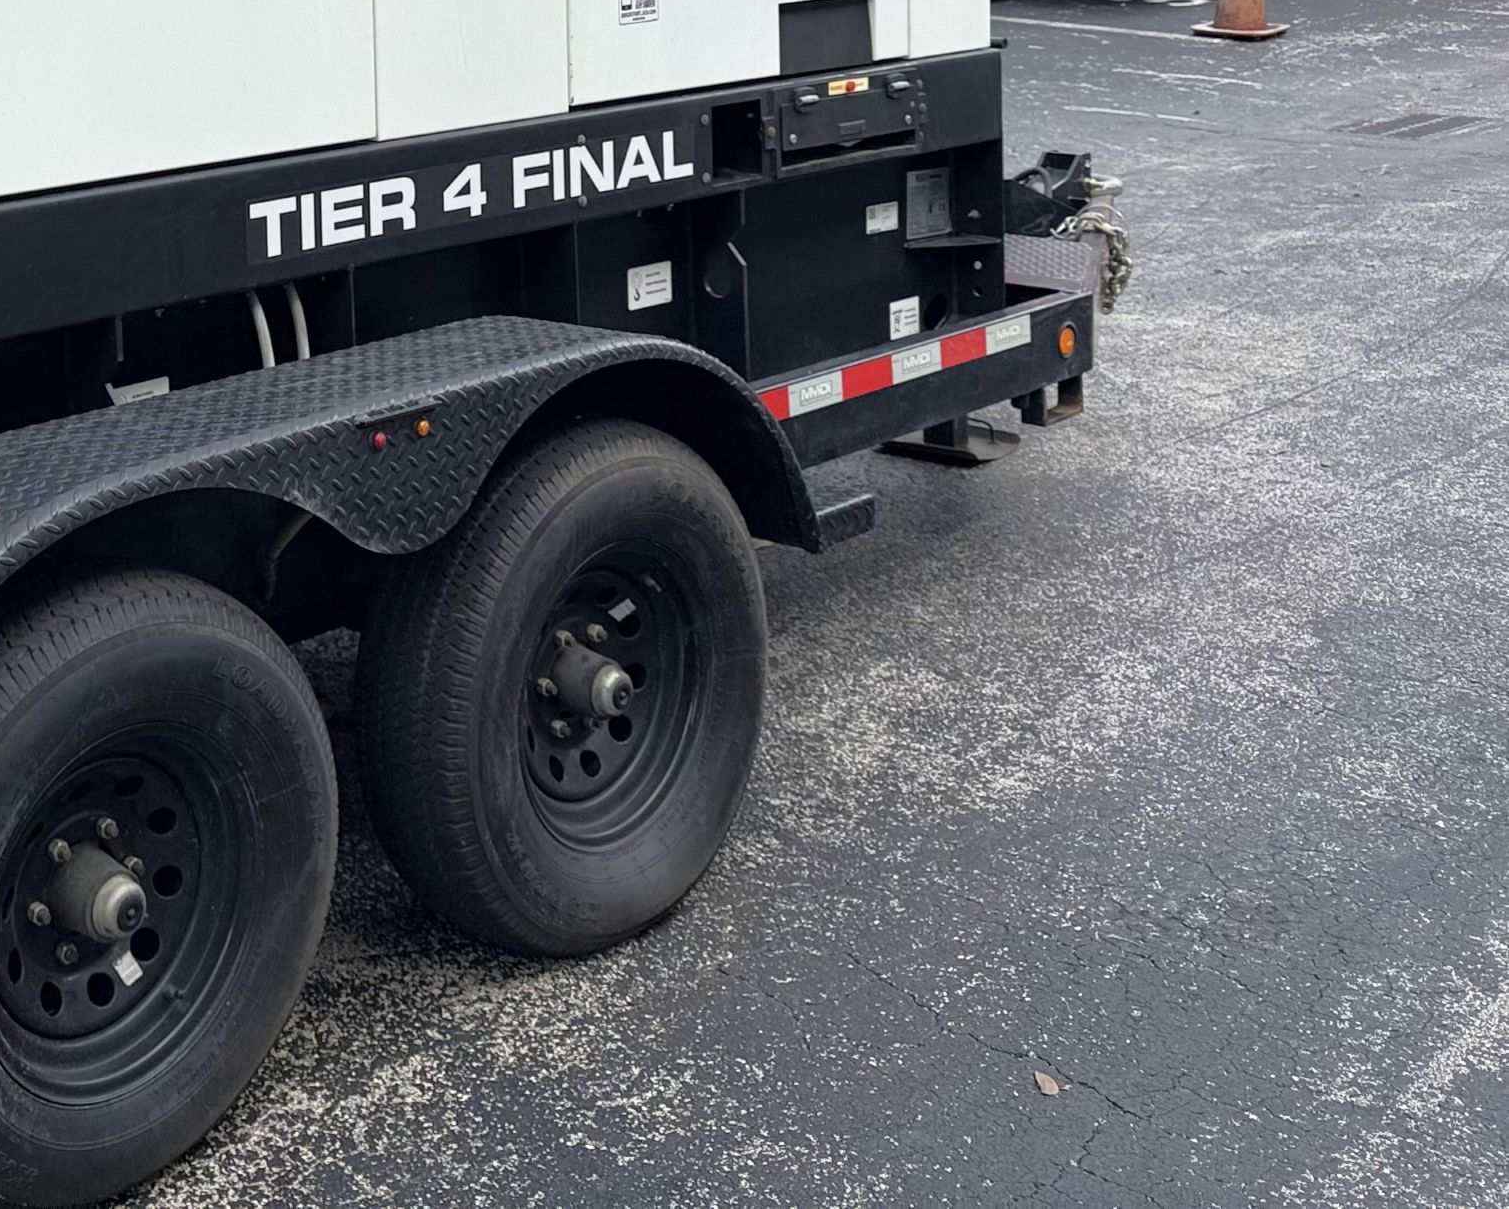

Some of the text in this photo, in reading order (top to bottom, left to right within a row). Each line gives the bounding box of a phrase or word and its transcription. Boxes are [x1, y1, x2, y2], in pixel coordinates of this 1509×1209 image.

[249, 130, 695, 259] TIER 4 FINAL
